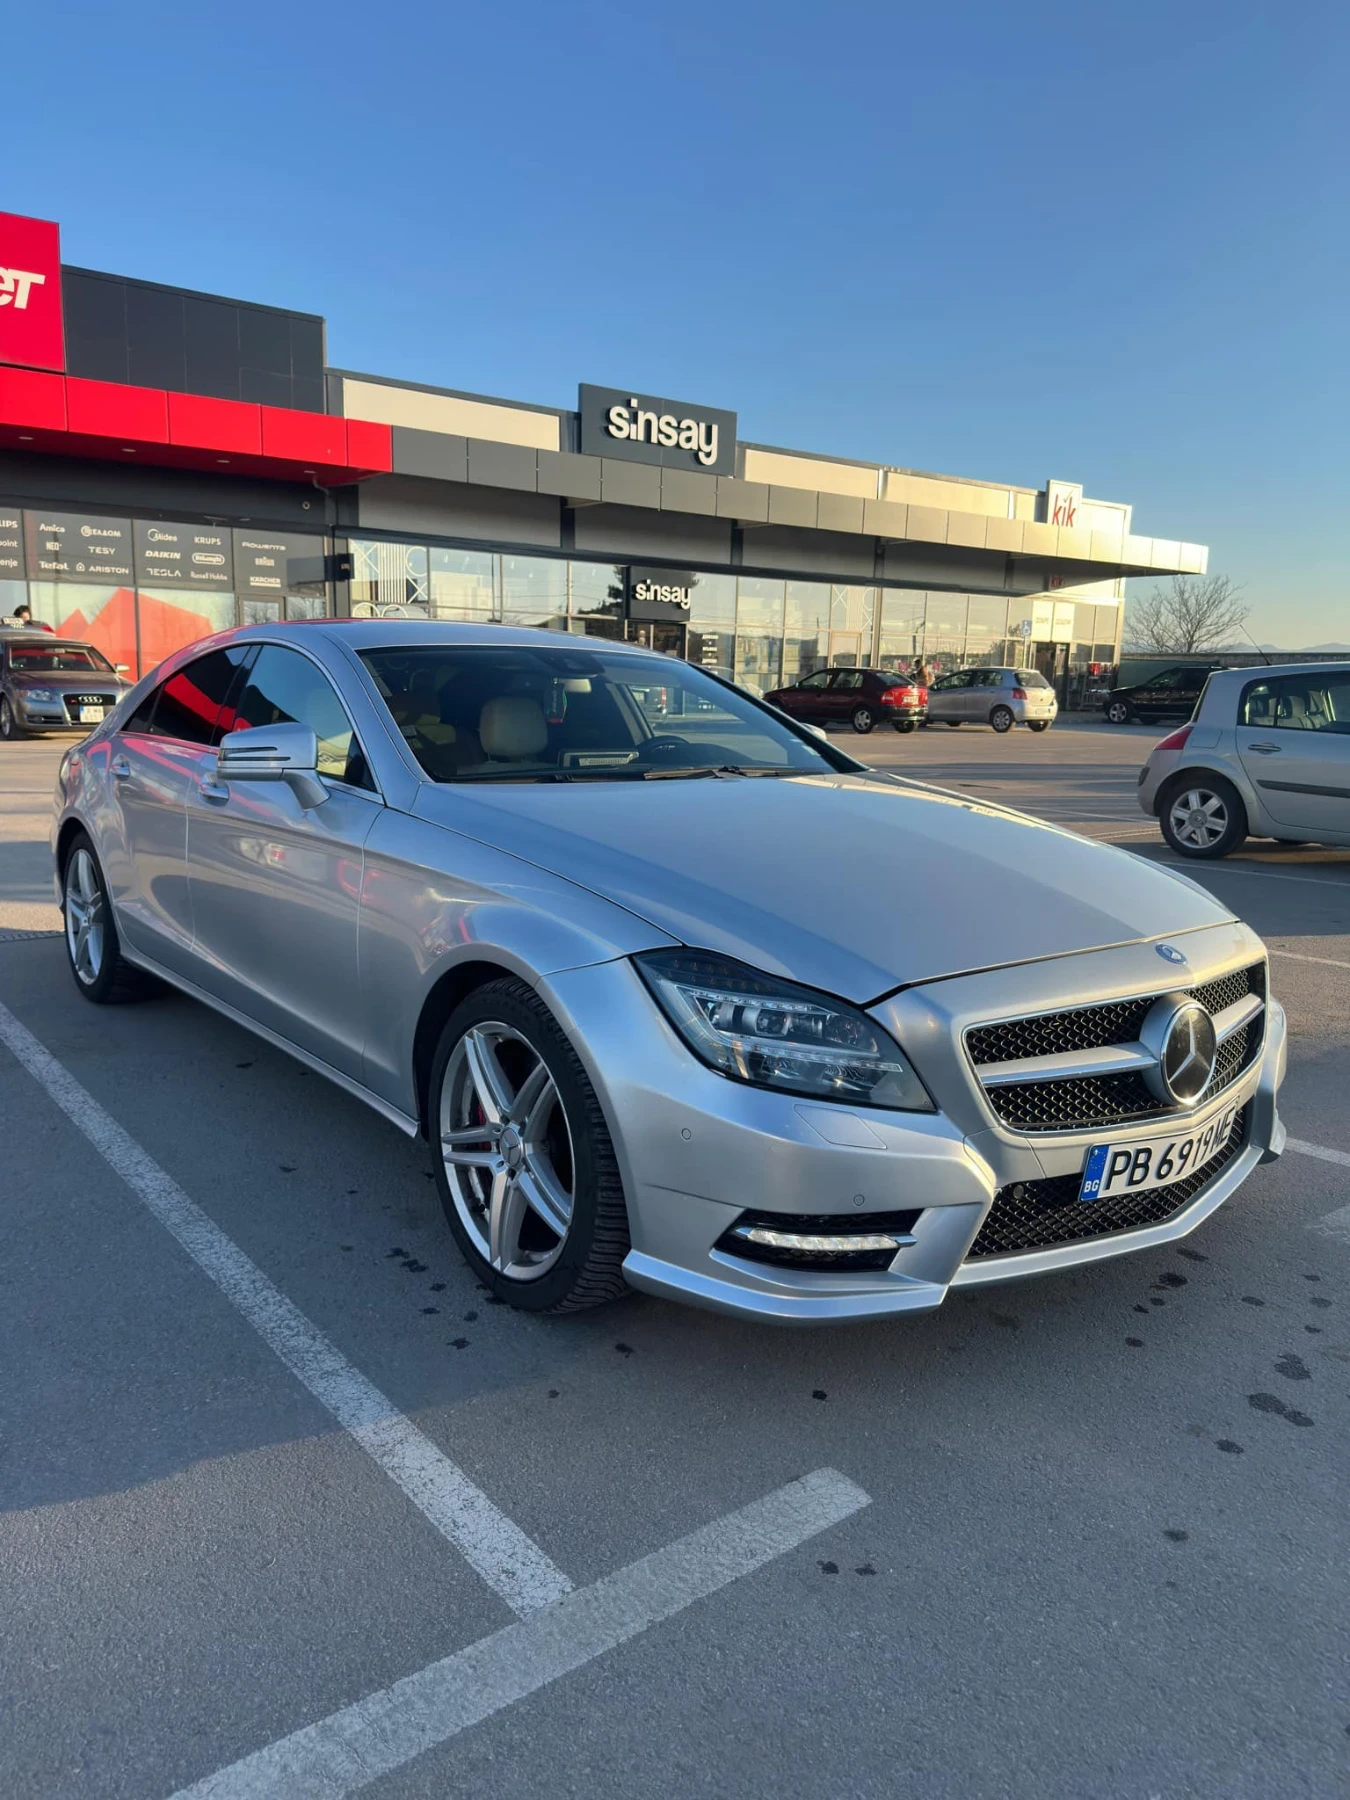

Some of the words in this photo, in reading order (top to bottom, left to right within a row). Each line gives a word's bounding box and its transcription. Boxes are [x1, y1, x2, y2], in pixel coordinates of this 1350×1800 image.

[608, 398, 718, 466] sinsay
[1051, 493, 1076, 528] kik
[39, 523, 65, 533] Amica
[194, 536, 222, 546] KRUPS
[88, 546, 116, 555] TESY
[145, 550, 181, 560] DAIKIN
[39, 561, 70, 571] Tefal
[89, 565, 129, 574] ARISTON
[146, 567, 181, 577] TESLA
[635, 579, 690, 610] sinsay
[1104, 1147, 1153, 1190] PB
[1084, 1179, 1100, 1194] BG
